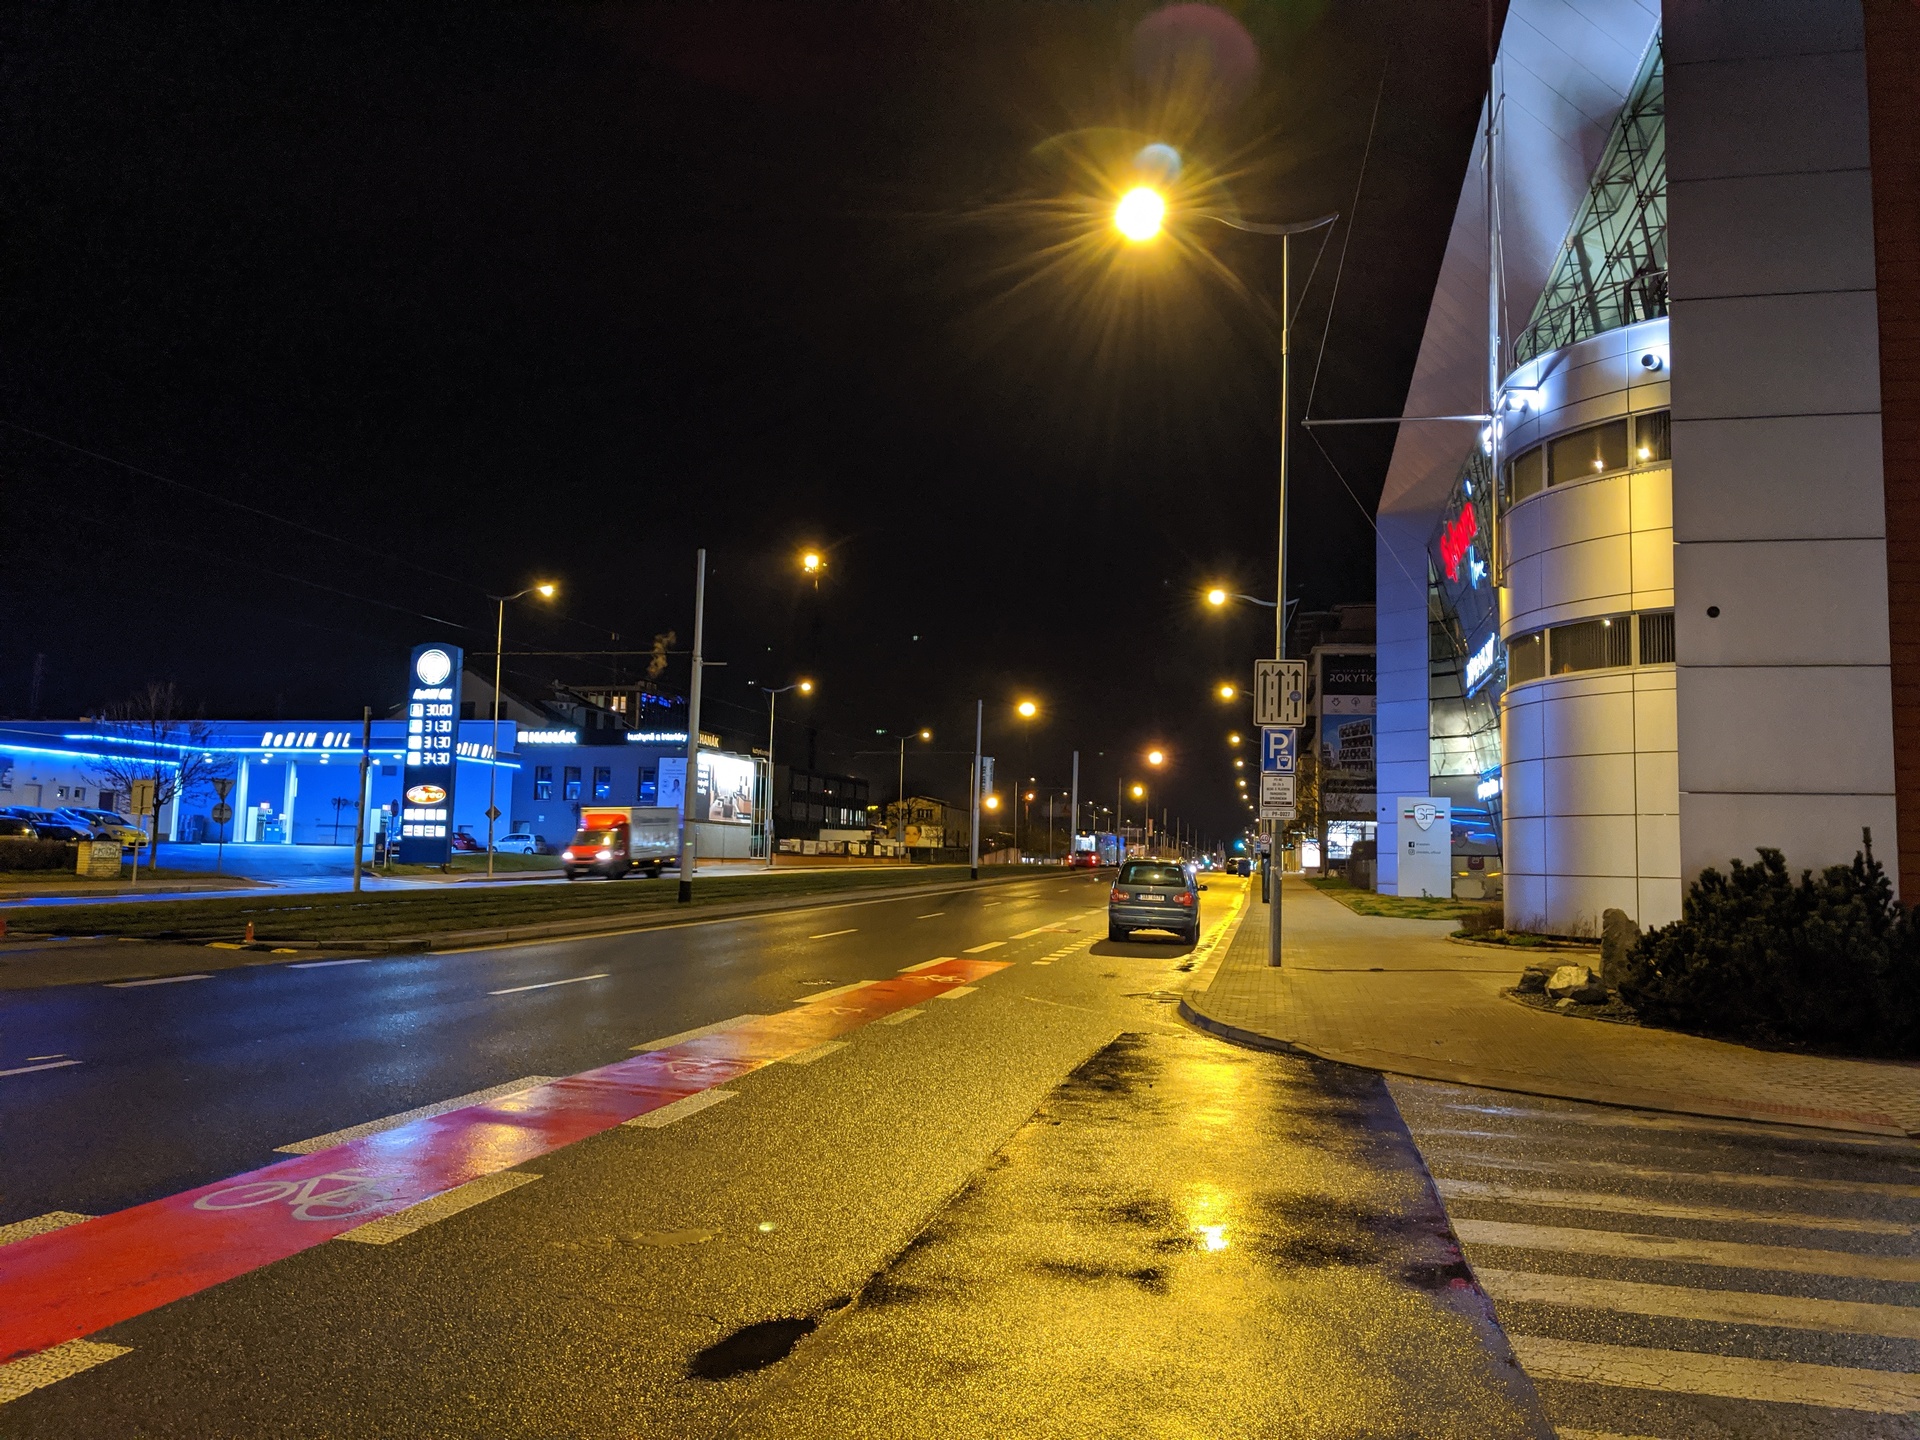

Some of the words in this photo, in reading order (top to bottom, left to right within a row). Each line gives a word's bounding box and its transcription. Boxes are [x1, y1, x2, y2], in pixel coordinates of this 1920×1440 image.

[322, 731, 351, 748] OIL
[699, 733, 720, 748] HANÁK
[1269, 732, 1289, 759] P
[1416, 807, 1435, 821] SF
